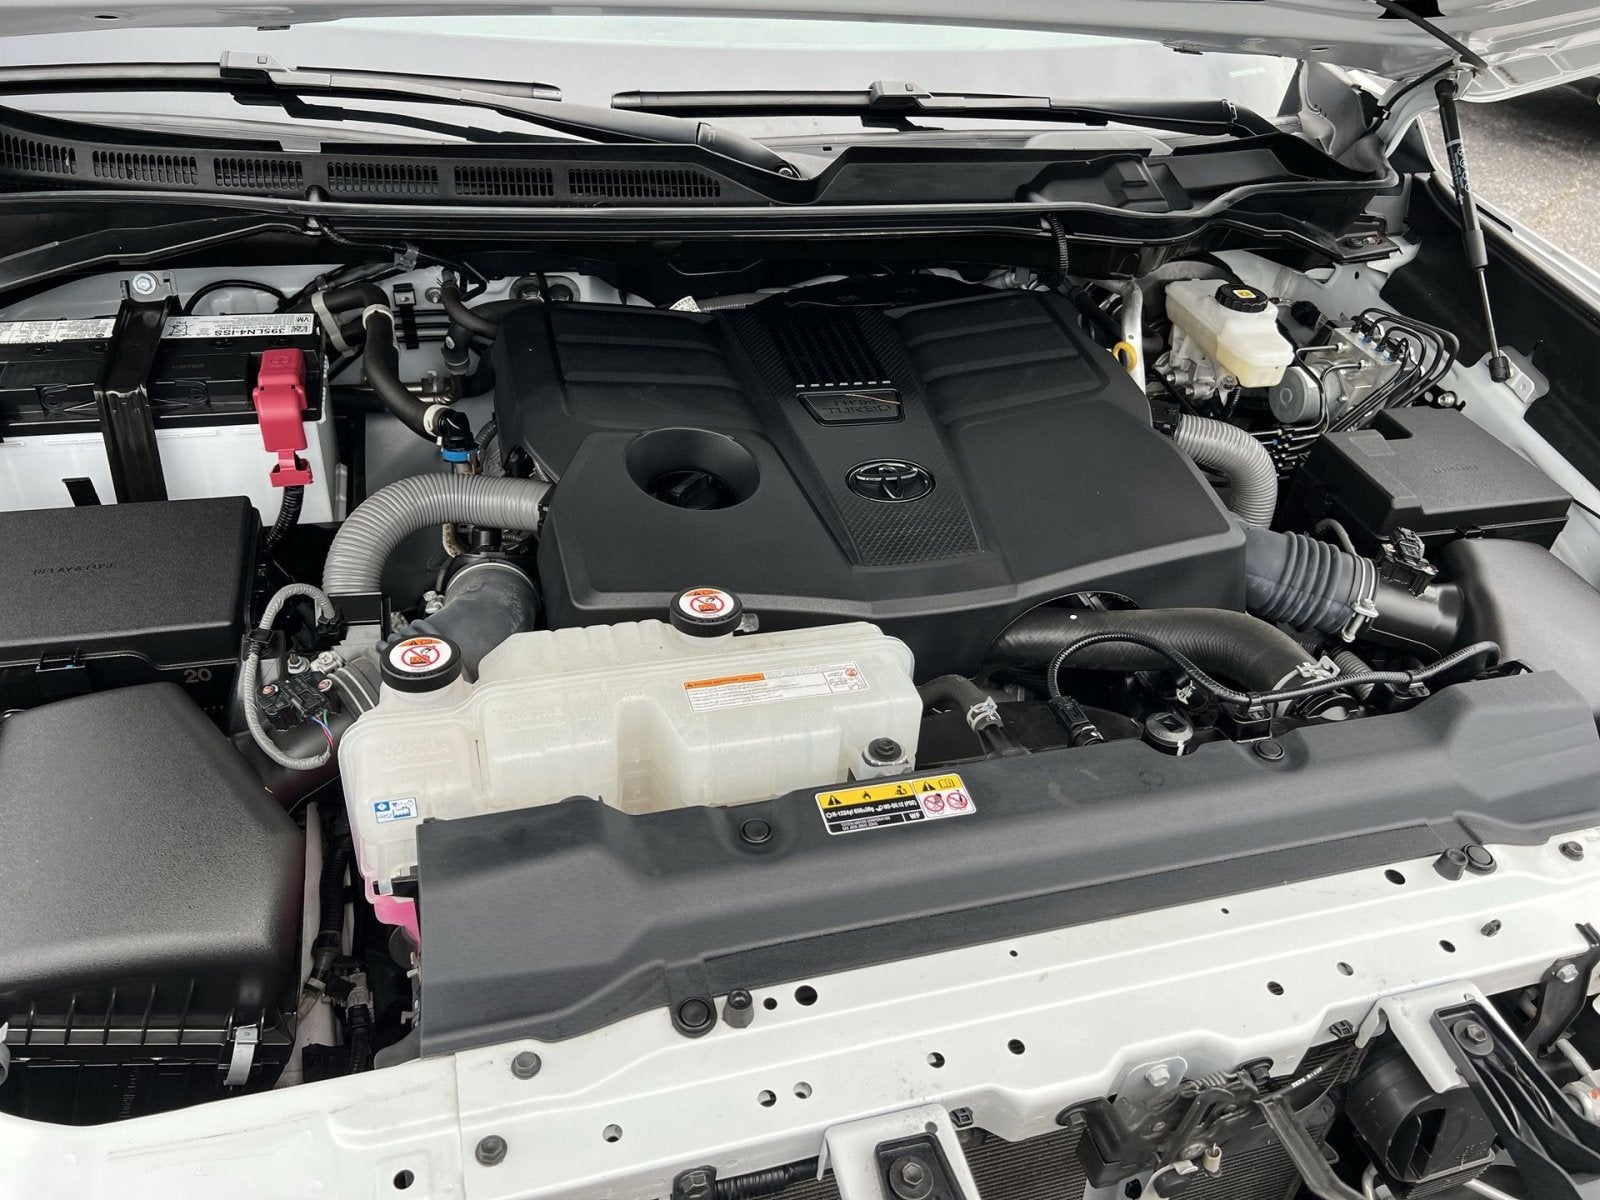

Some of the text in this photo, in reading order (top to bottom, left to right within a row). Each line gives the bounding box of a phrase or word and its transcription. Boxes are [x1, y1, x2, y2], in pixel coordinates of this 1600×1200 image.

[214, 328, 286, 336] 395LN4-ISS
[822, 404, 891, 414] TURBO
[183, 668, 212, 683] 20
[909, 812, 921, 820] WF
